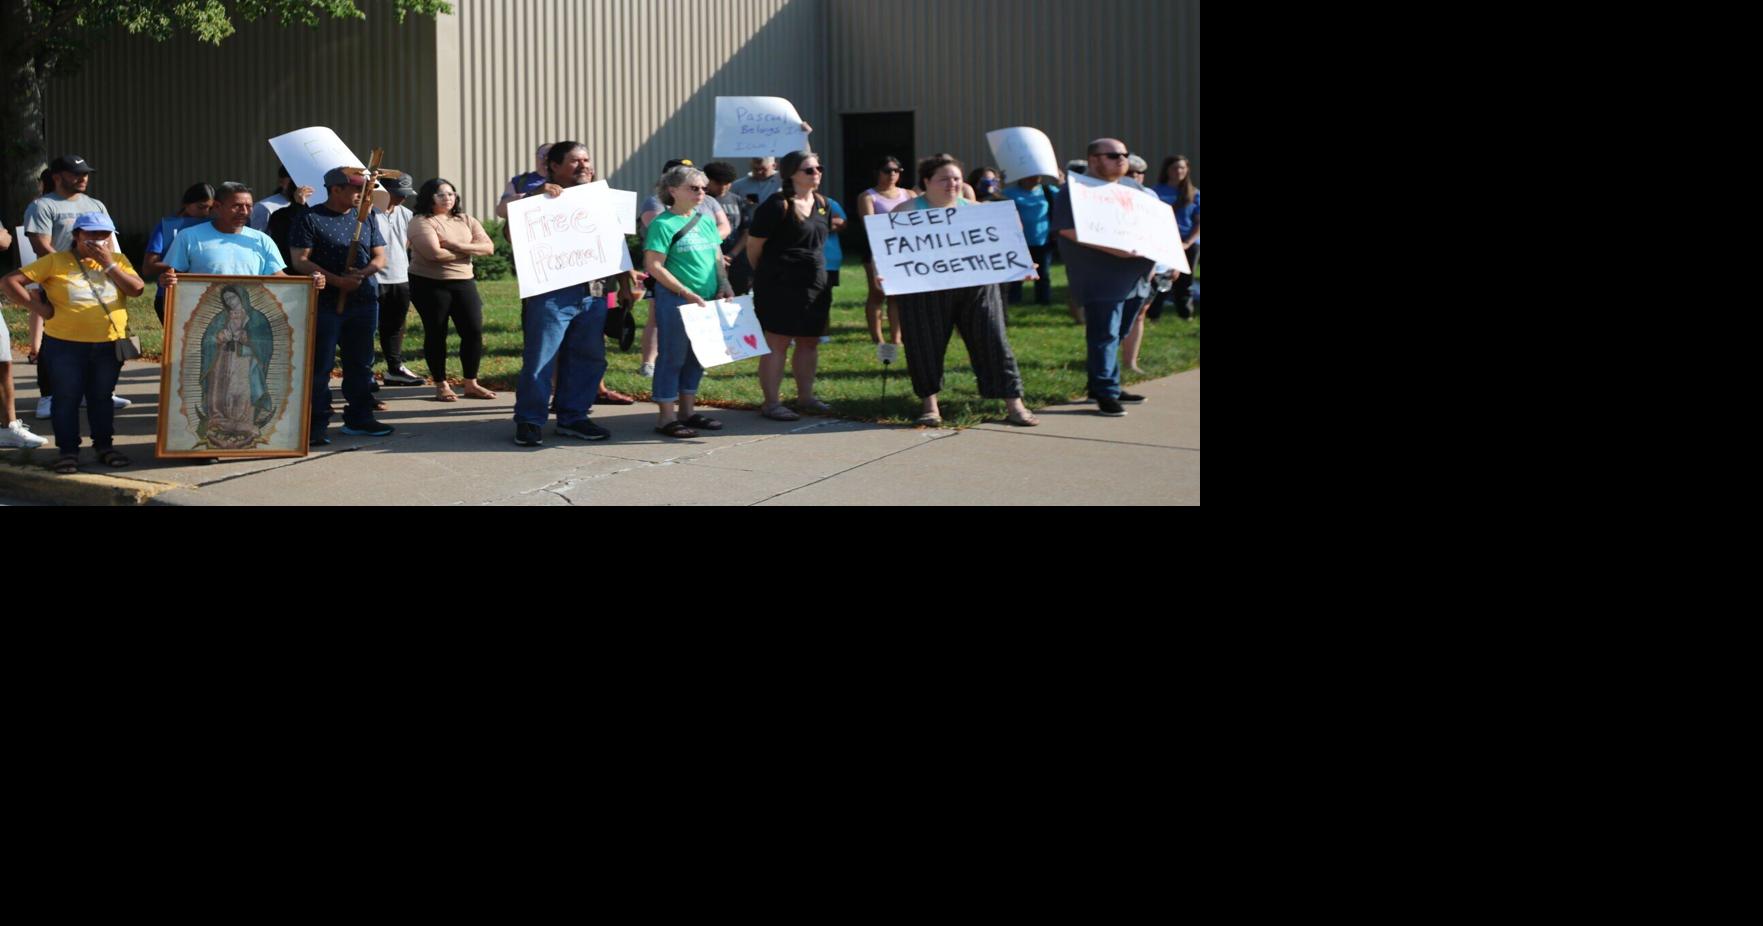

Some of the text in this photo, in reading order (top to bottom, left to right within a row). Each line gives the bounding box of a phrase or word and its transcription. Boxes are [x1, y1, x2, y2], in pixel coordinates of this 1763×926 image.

[524, 205, 598, 242] Free
[888, 207, 957, 229] KEEP
[884, 226, 1000, 255] FAMILIES
[894, 250, 1028, 277] TOGETHER
